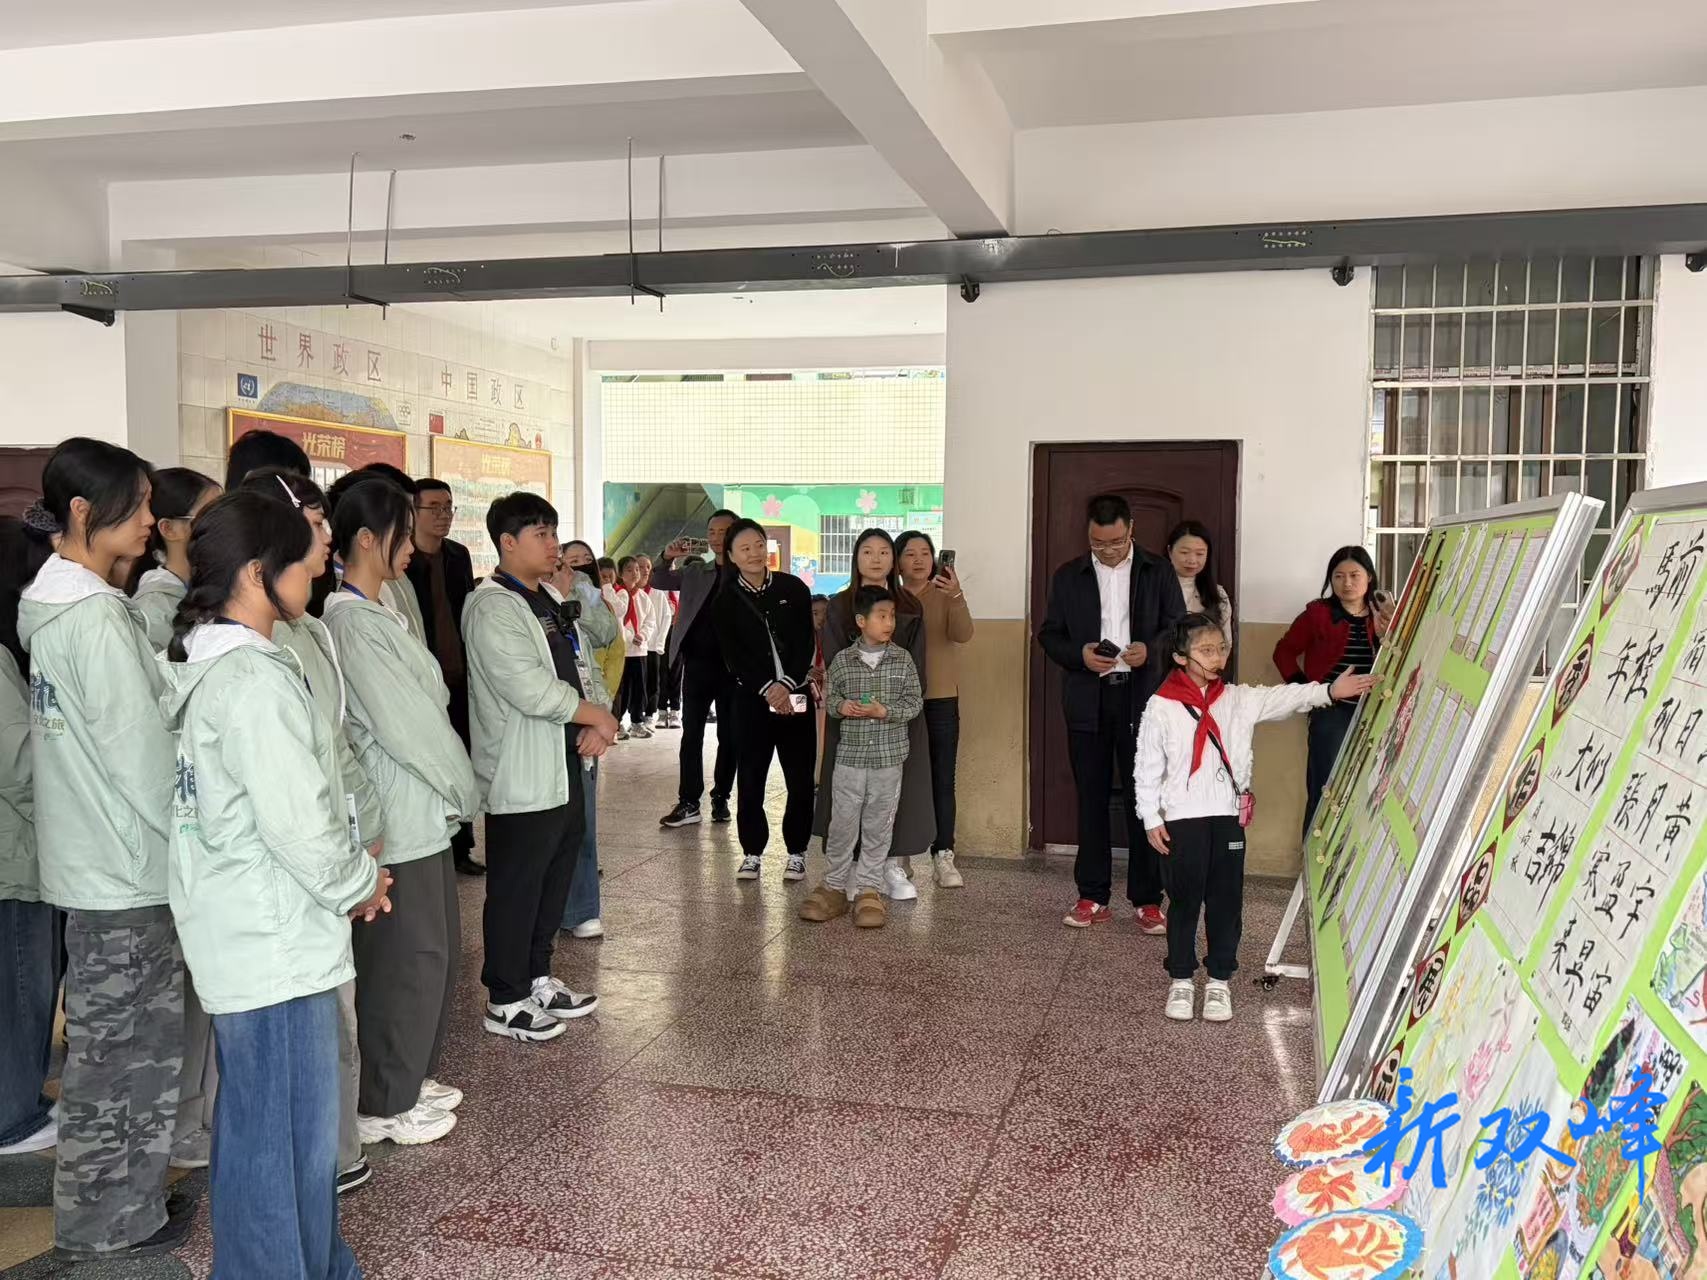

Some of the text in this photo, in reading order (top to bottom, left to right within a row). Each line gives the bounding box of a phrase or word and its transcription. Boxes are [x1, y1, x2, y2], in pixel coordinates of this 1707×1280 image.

[258, 323, 382, 383] 世界政区
[440, 364, 527, 410] 中国政区
[302, 431, 346, 460] 光荣榜
